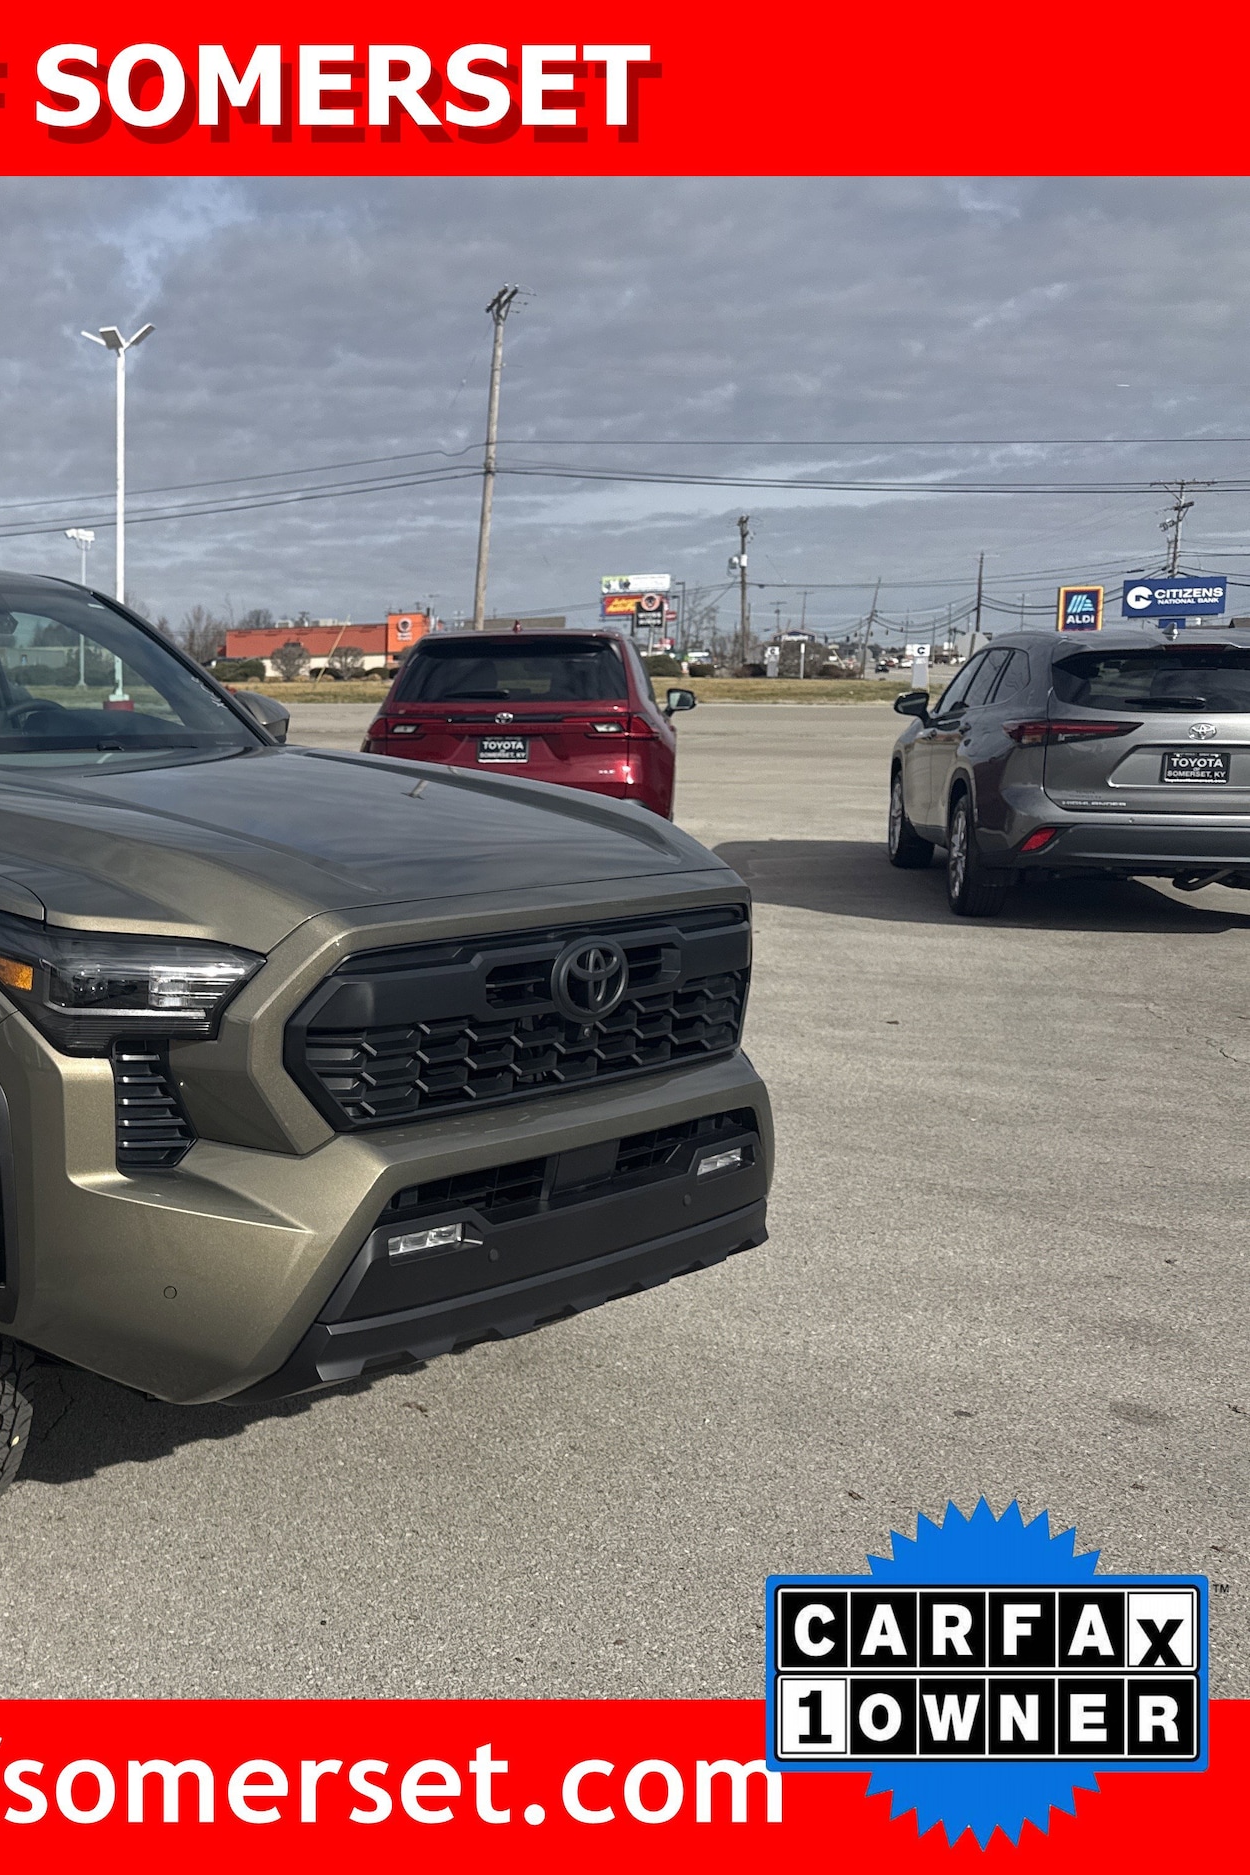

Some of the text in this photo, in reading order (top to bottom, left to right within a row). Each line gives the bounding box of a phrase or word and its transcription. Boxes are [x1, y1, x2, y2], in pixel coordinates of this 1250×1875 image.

[1154, 587, 1224, 599] CITIZENS
[1066, 614, 1095, 625] ALDI
[482, 741, 525, 750] TOYOTA
[1171, 758, 1223, 768] TOYOTA
[1167, 770, 1213, 778] SOMERSET,
